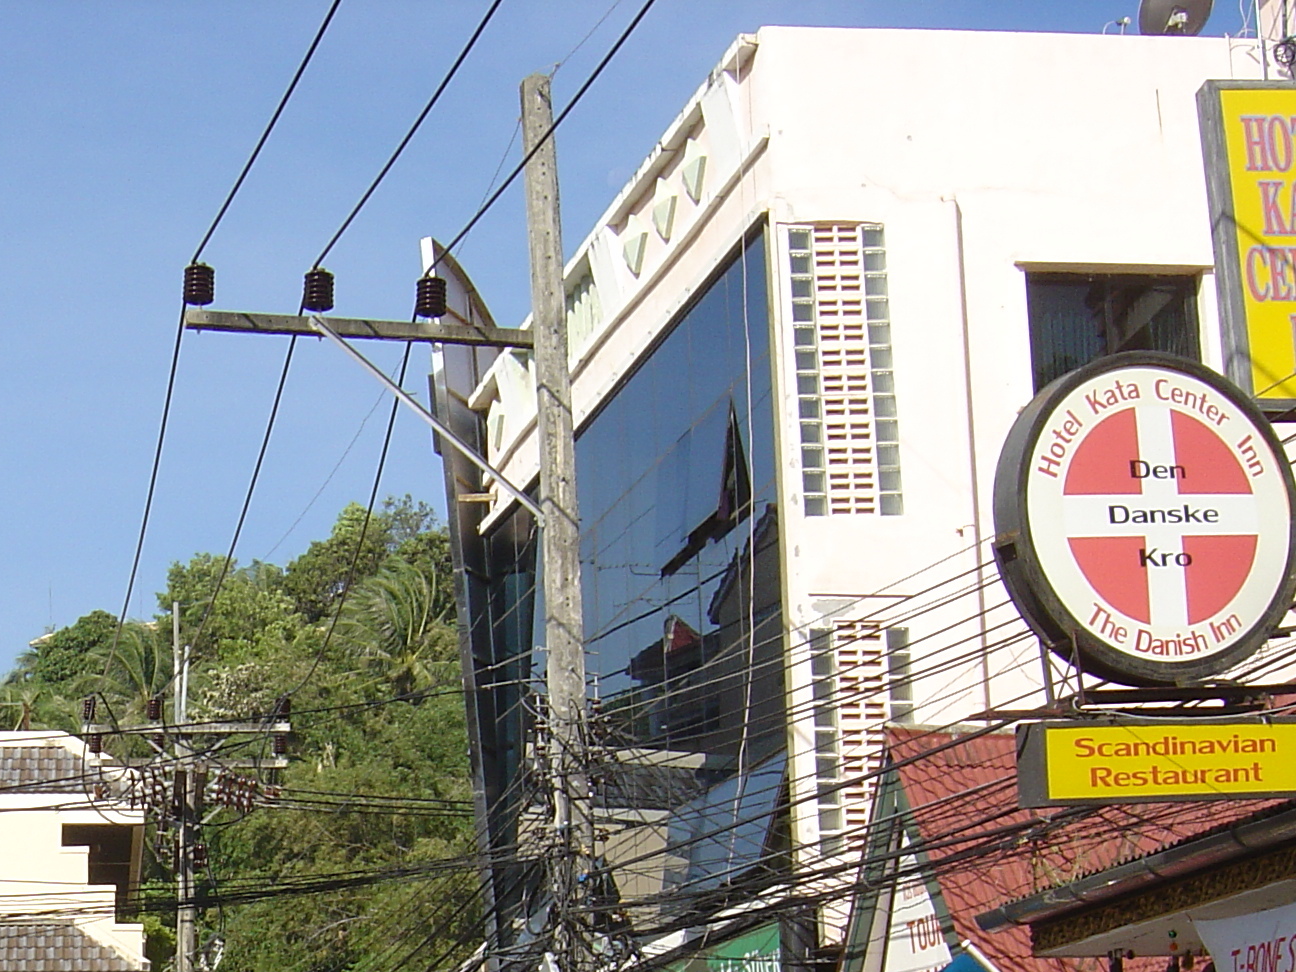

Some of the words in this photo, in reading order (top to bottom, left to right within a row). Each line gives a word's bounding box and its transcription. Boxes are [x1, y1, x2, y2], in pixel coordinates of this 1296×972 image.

[1240, 114, 1296, 173] HO
[1038, 410, 1084, 479] Hotel
[1084, 380, 1141, 415] Kata
[1154, 378, 1231, 427] Center
[1236, 434, 1265, 479] Inn
[1129, 460, 1186, 480] Den
[1108, 505, 1220, 525] Danske
[1139, 549, 1193, 568] Kro
[1088, 603, 1128, 645] The
[1135, 629, 1210, 657] Danish
[1210, 612, 1244, 643] Inn
[1074, 735, 1277, 759] Scandinavian
[1090, 762, 1264, 788] Restaurant
